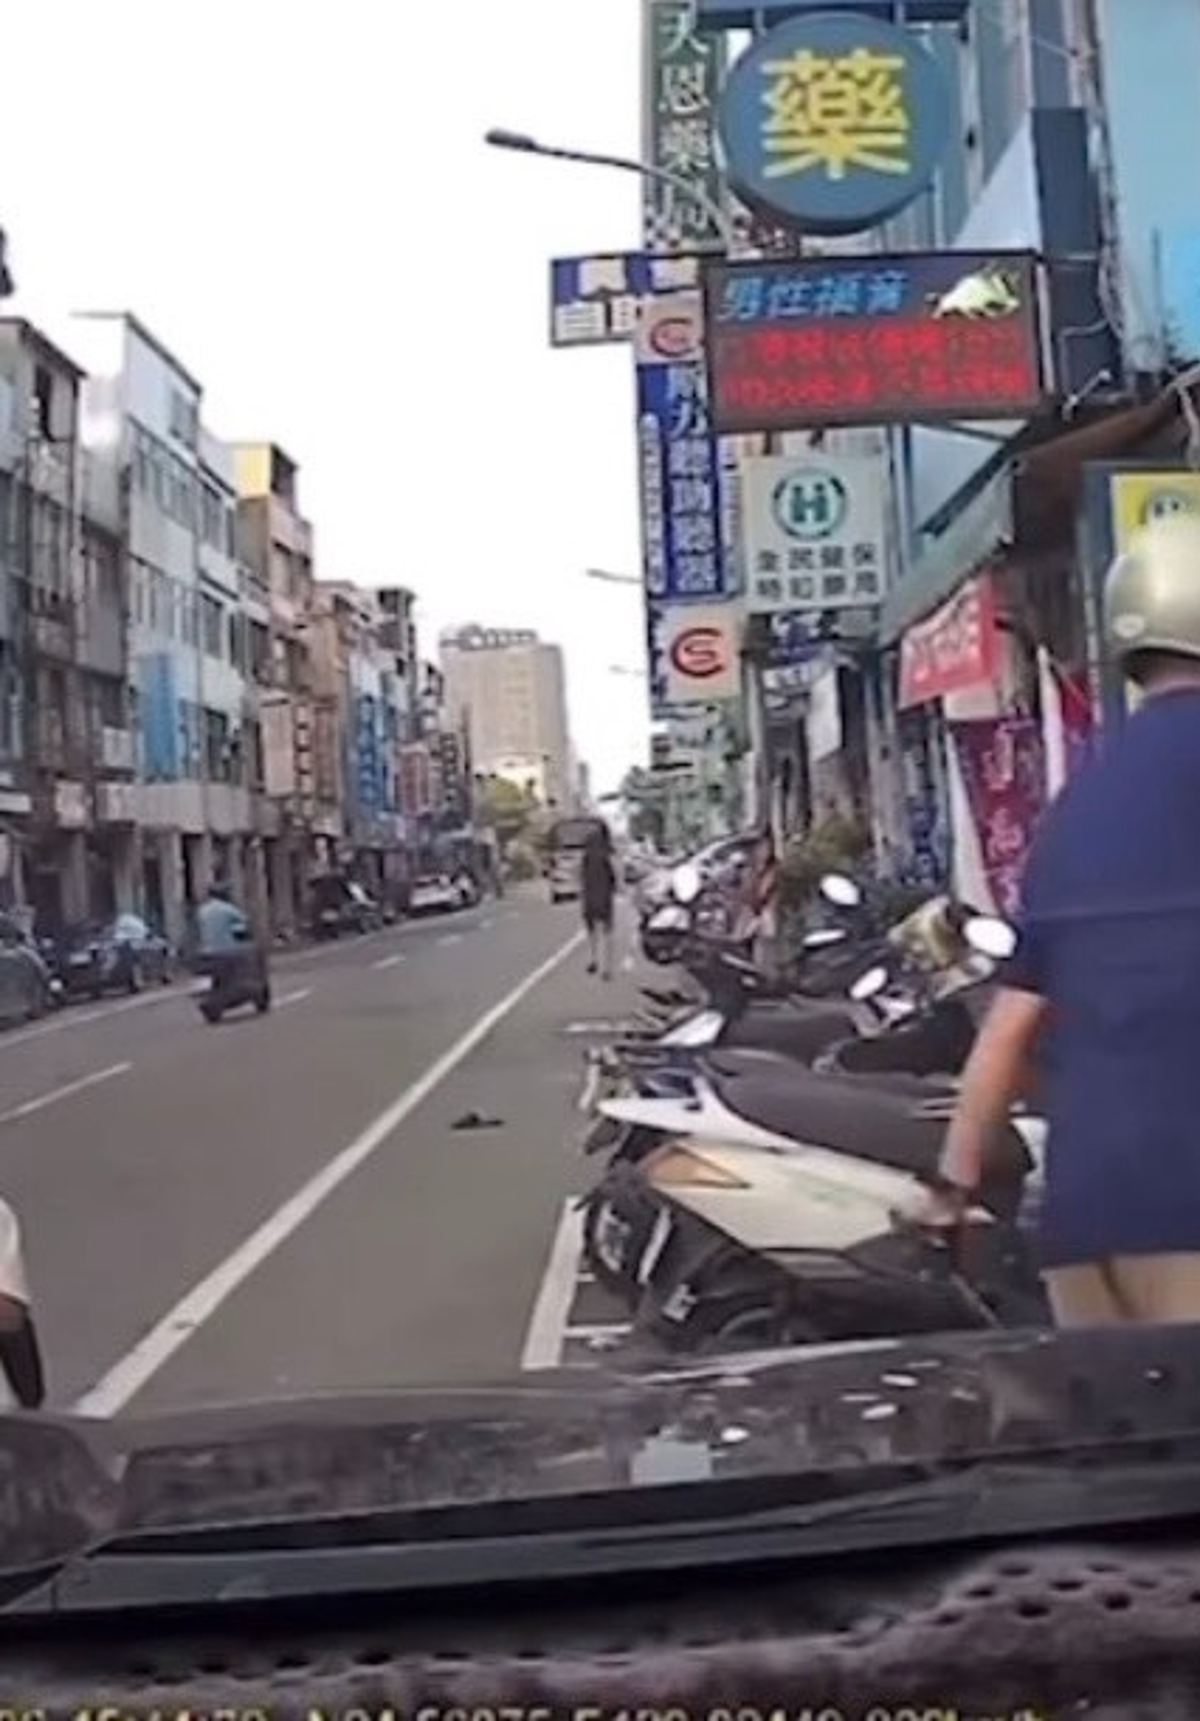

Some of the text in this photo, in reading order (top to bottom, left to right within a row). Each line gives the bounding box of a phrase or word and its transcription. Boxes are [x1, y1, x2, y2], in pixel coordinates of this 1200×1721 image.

[762, 48, 910, 181] 藥
[716, 270, 908, 322] 男性福音
